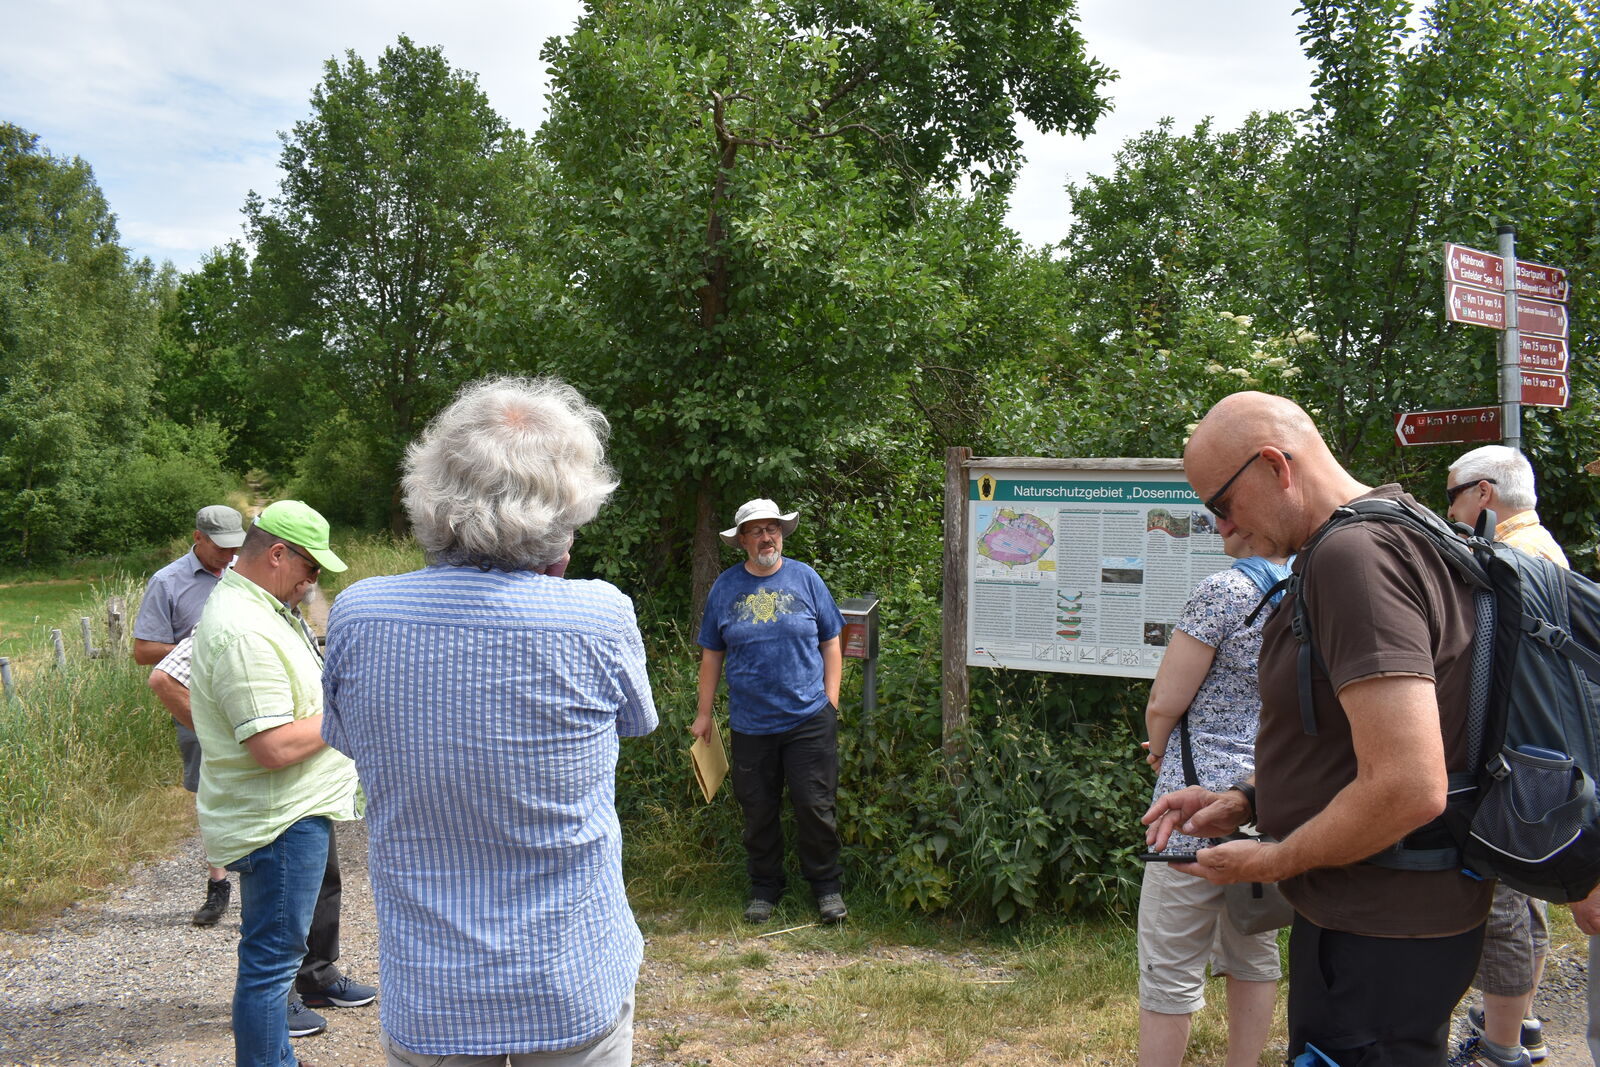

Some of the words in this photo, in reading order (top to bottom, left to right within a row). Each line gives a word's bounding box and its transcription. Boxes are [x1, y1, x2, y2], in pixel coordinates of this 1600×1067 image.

[1460, 268, 1482, 281] Einfelder
[1484, 274, 1493, 284] See
[1520, 268, 1546, 280] Startpunkt
[1467, 294, 1476, 304] Km
[1484, 299, 1493, 307] von
[1468, 308, 1476, 318] Km
[1485, 313, 1494, 321] von
[1523, 341, 1531, 350] Km
[1540, 344, 1548, 352] von
[1523, 354, 1531, 363] Km
[1523, 377, 1532, 386] Km
[1427, 416, 1443, 425] Km
[1460, 415, 1477, 423] von
[1013, 485, 1123, 500] Naturschutzgebiet
